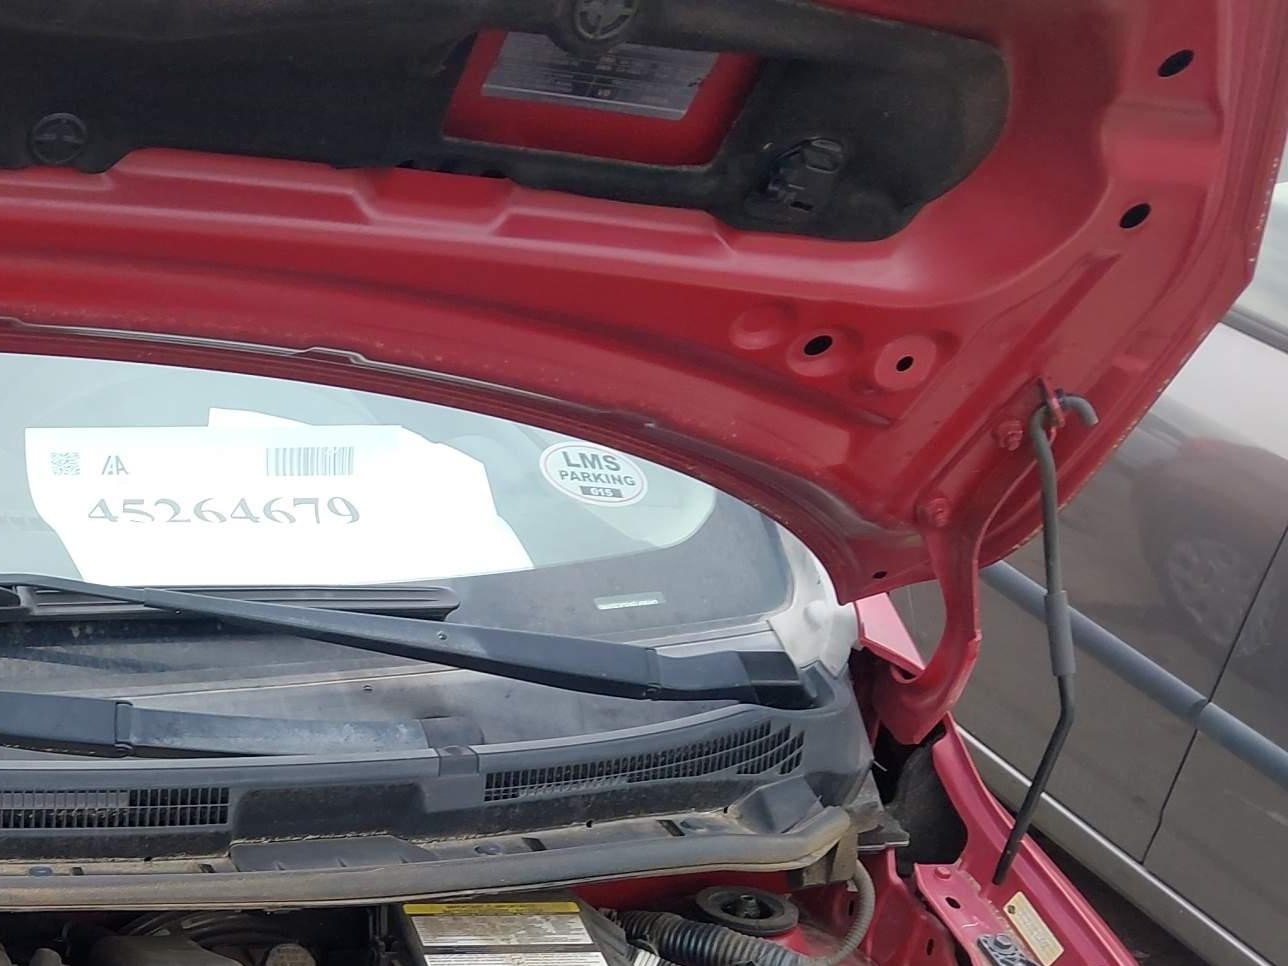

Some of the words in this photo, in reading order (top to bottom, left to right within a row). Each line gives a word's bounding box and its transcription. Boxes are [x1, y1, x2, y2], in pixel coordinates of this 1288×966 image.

[562, 451, 621, 472] LMS
[559, 470, 637, 487] PARKING
[87, 496, 361, 525] 45264679
